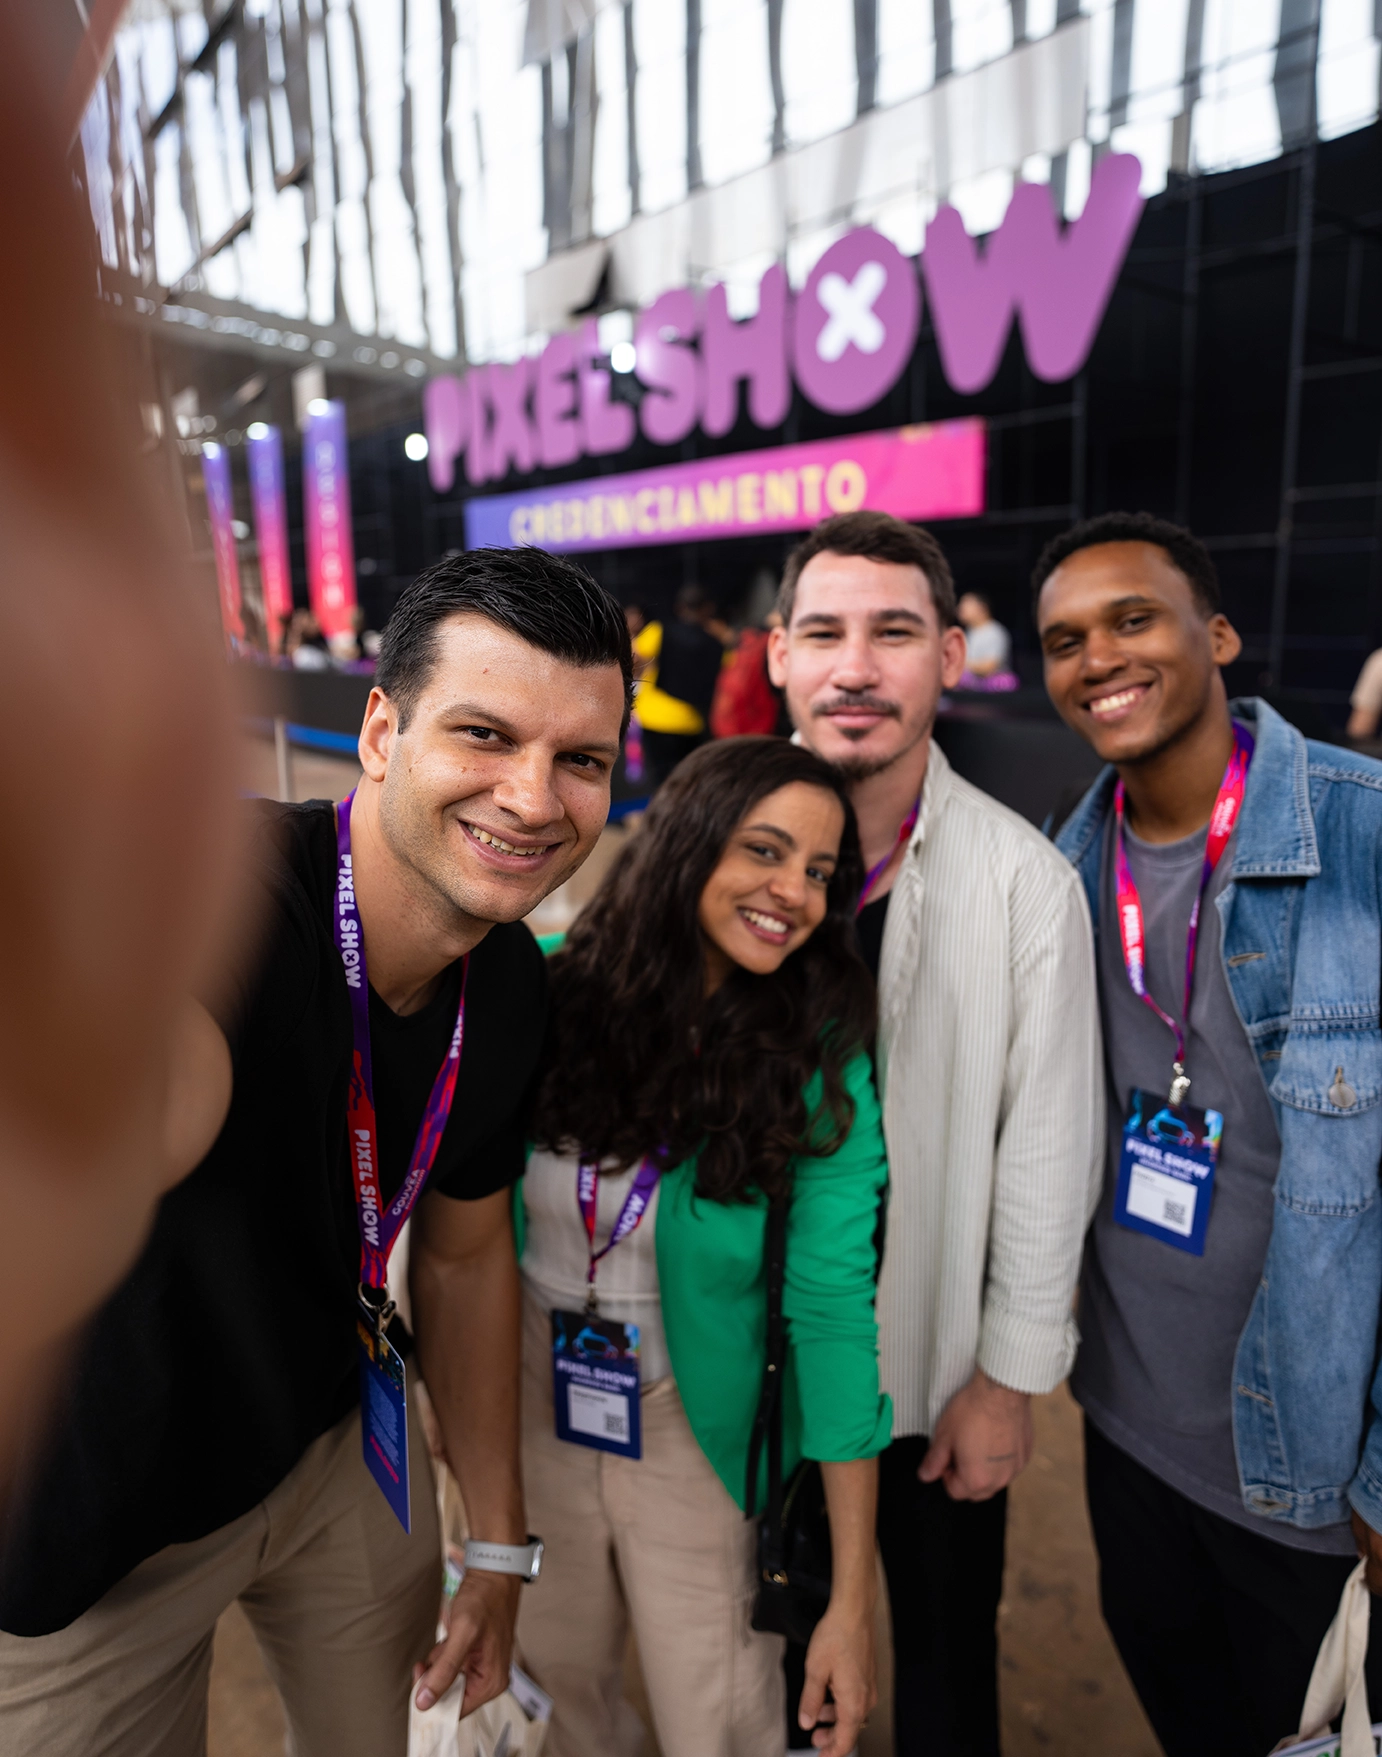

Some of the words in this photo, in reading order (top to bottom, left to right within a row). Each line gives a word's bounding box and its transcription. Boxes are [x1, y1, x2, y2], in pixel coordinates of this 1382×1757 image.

[423, 314, 636, 494] PIXEL
[632, 153, 1145, 446] SHOW
[338, 854, 355, 916] PIXEL
[340, 918, 362, 989] SHOW
[354, 1129, 373, 1182] PIXEL
[359, 1184, 379, 1247] SHOW
